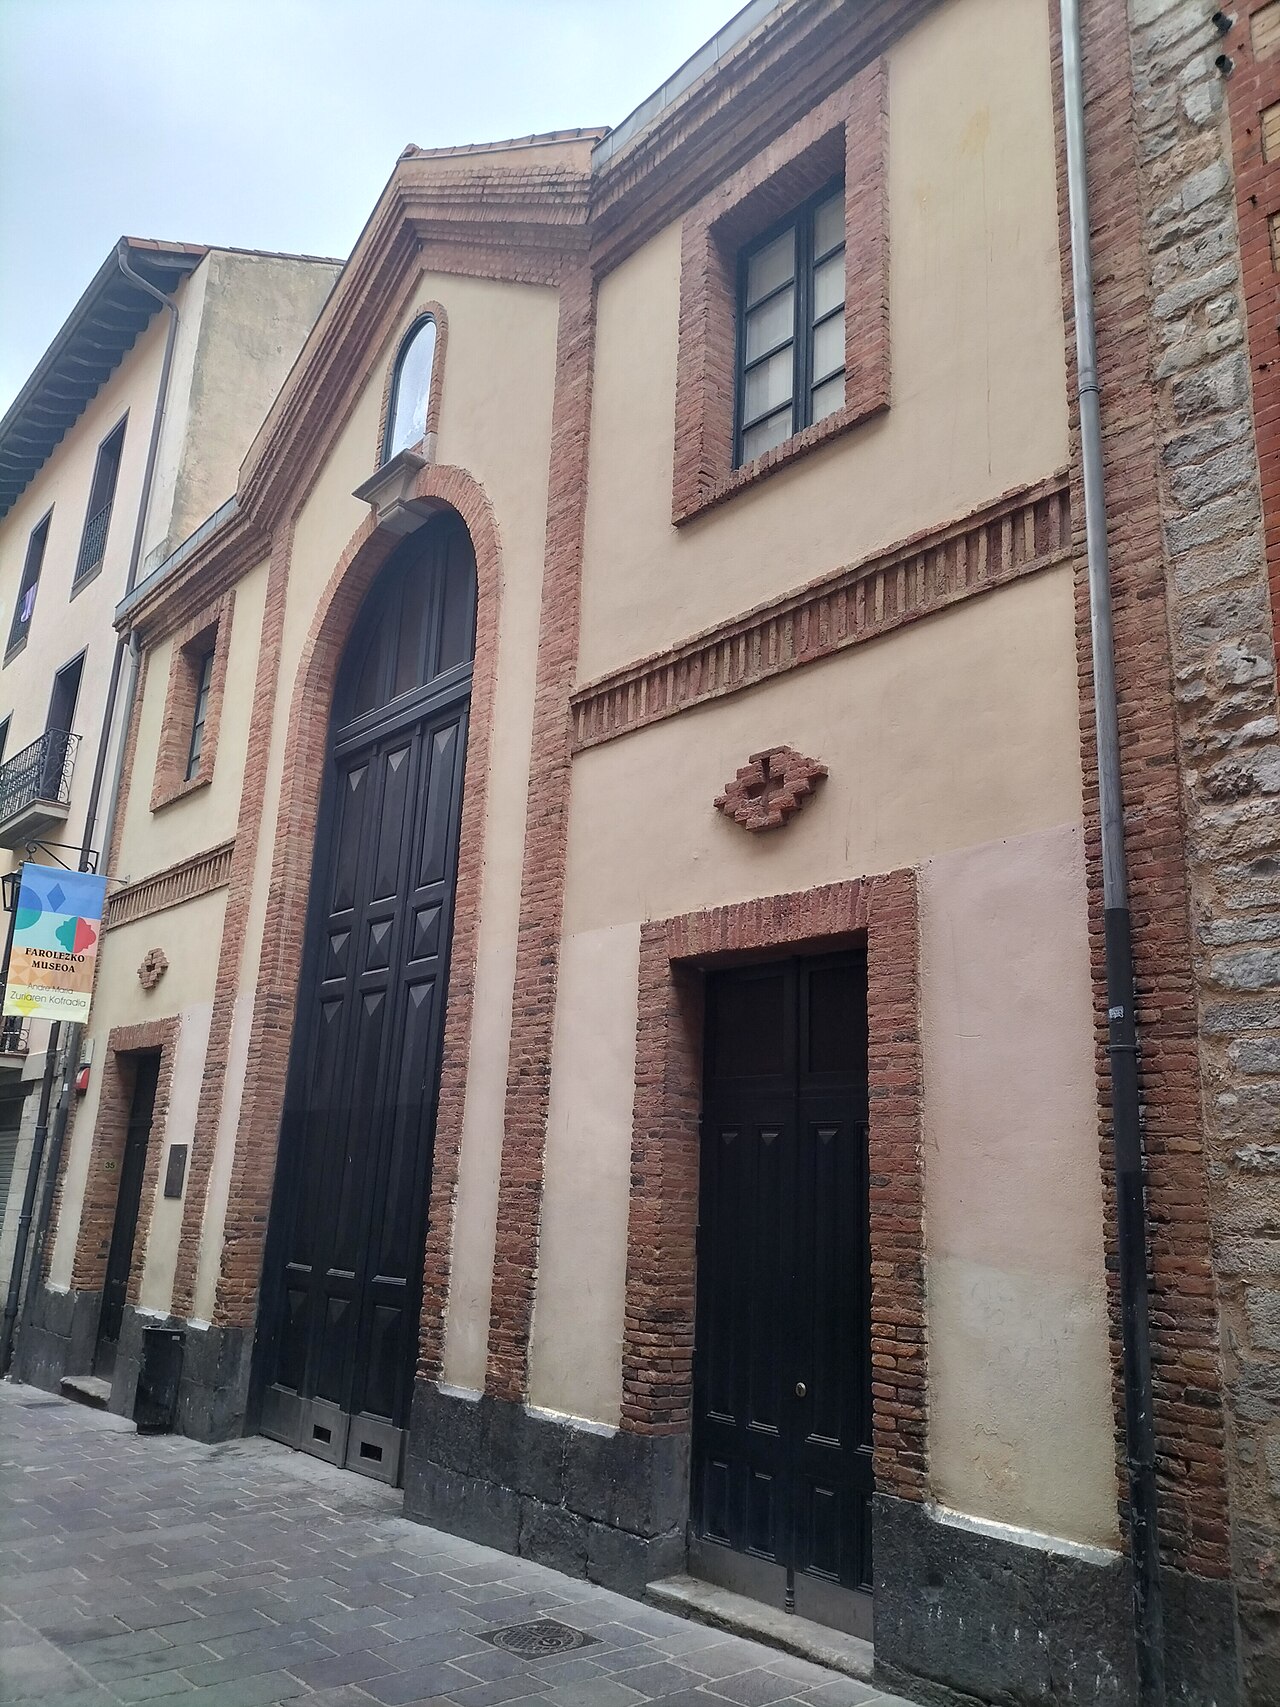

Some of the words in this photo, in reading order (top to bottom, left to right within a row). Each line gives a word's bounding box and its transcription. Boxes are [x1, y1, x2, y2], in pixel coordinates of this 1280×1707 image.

[25, 948, 85, 963] FAROLEZKO
[31, 960, 75, 973] MUSEOA
[52, 986, 74, 995] Maria
[10, 991, 47, 1003] Zuriaren
[49, 995, 86, 1008] Kofradia
[105, 1161, 115, 1169] 35
